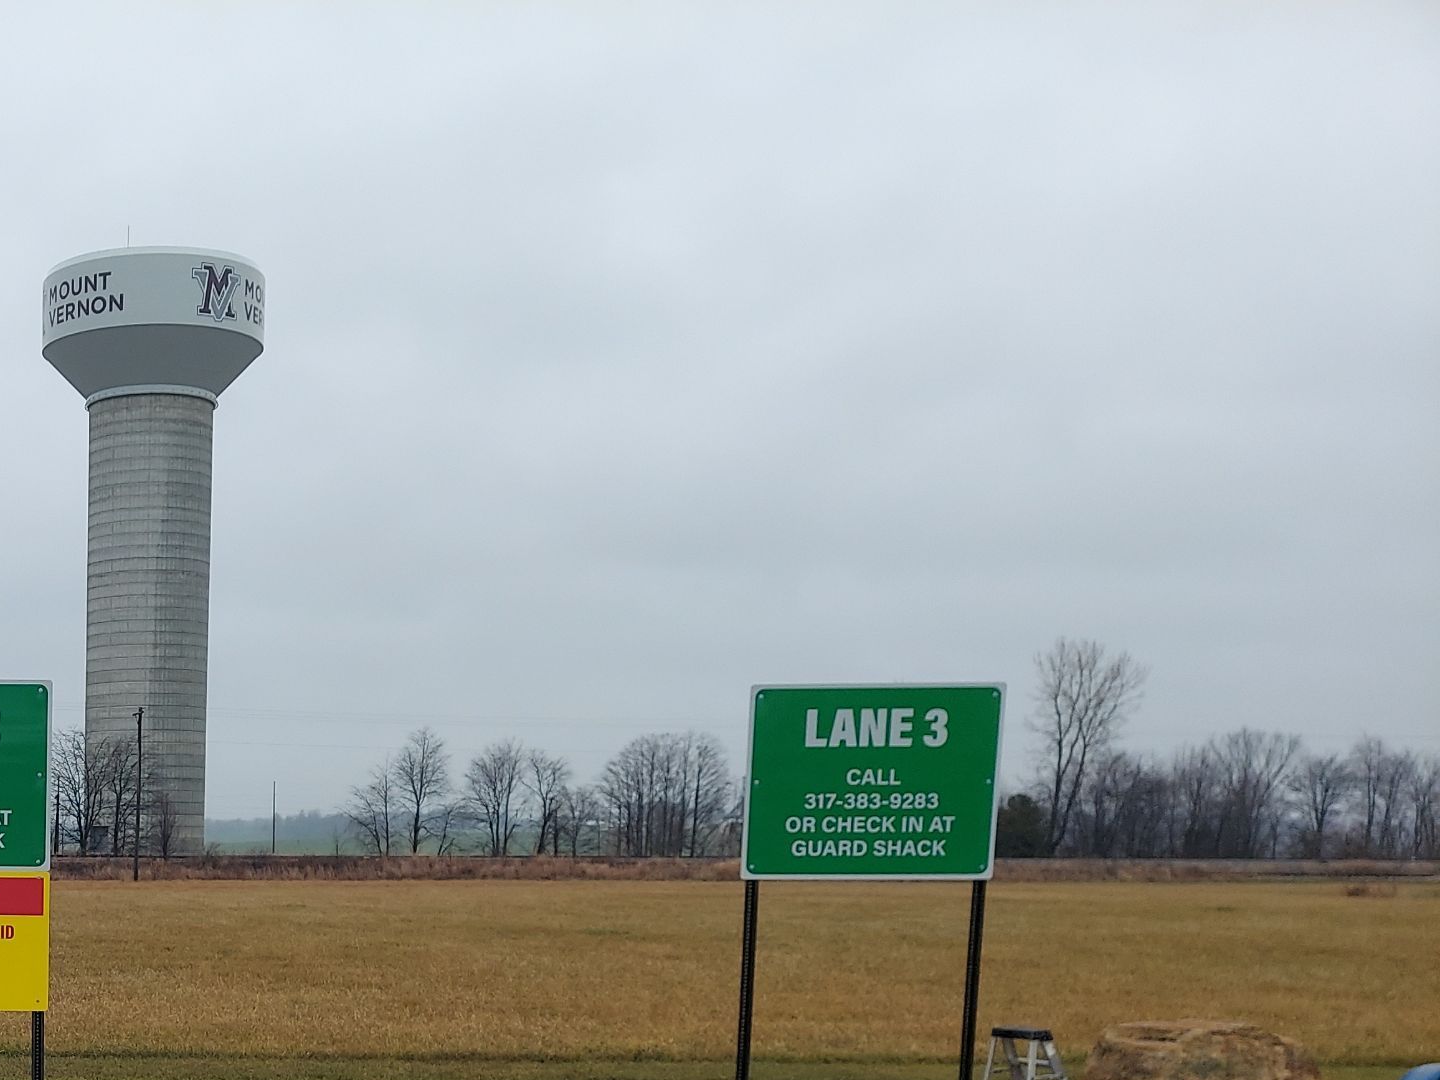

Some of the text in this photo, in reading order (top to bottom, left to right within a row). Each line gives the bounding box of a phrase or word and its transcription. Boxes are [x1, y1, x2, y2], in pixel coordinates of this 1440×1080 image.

[50, 272, 112, 306] MOUNT
[49, 293, 124, 327] VERNON
[805, 708, 949, 747] LANE 3
[846, 769, 901, 785] CALL
[804, 793, 938, 809] 317-383-9283
[786, 816, 955, 833] OR CHECK IN AT
[791, 840, 946, 857] GUARD SHACK
[1, 925, 14, 939] ID
